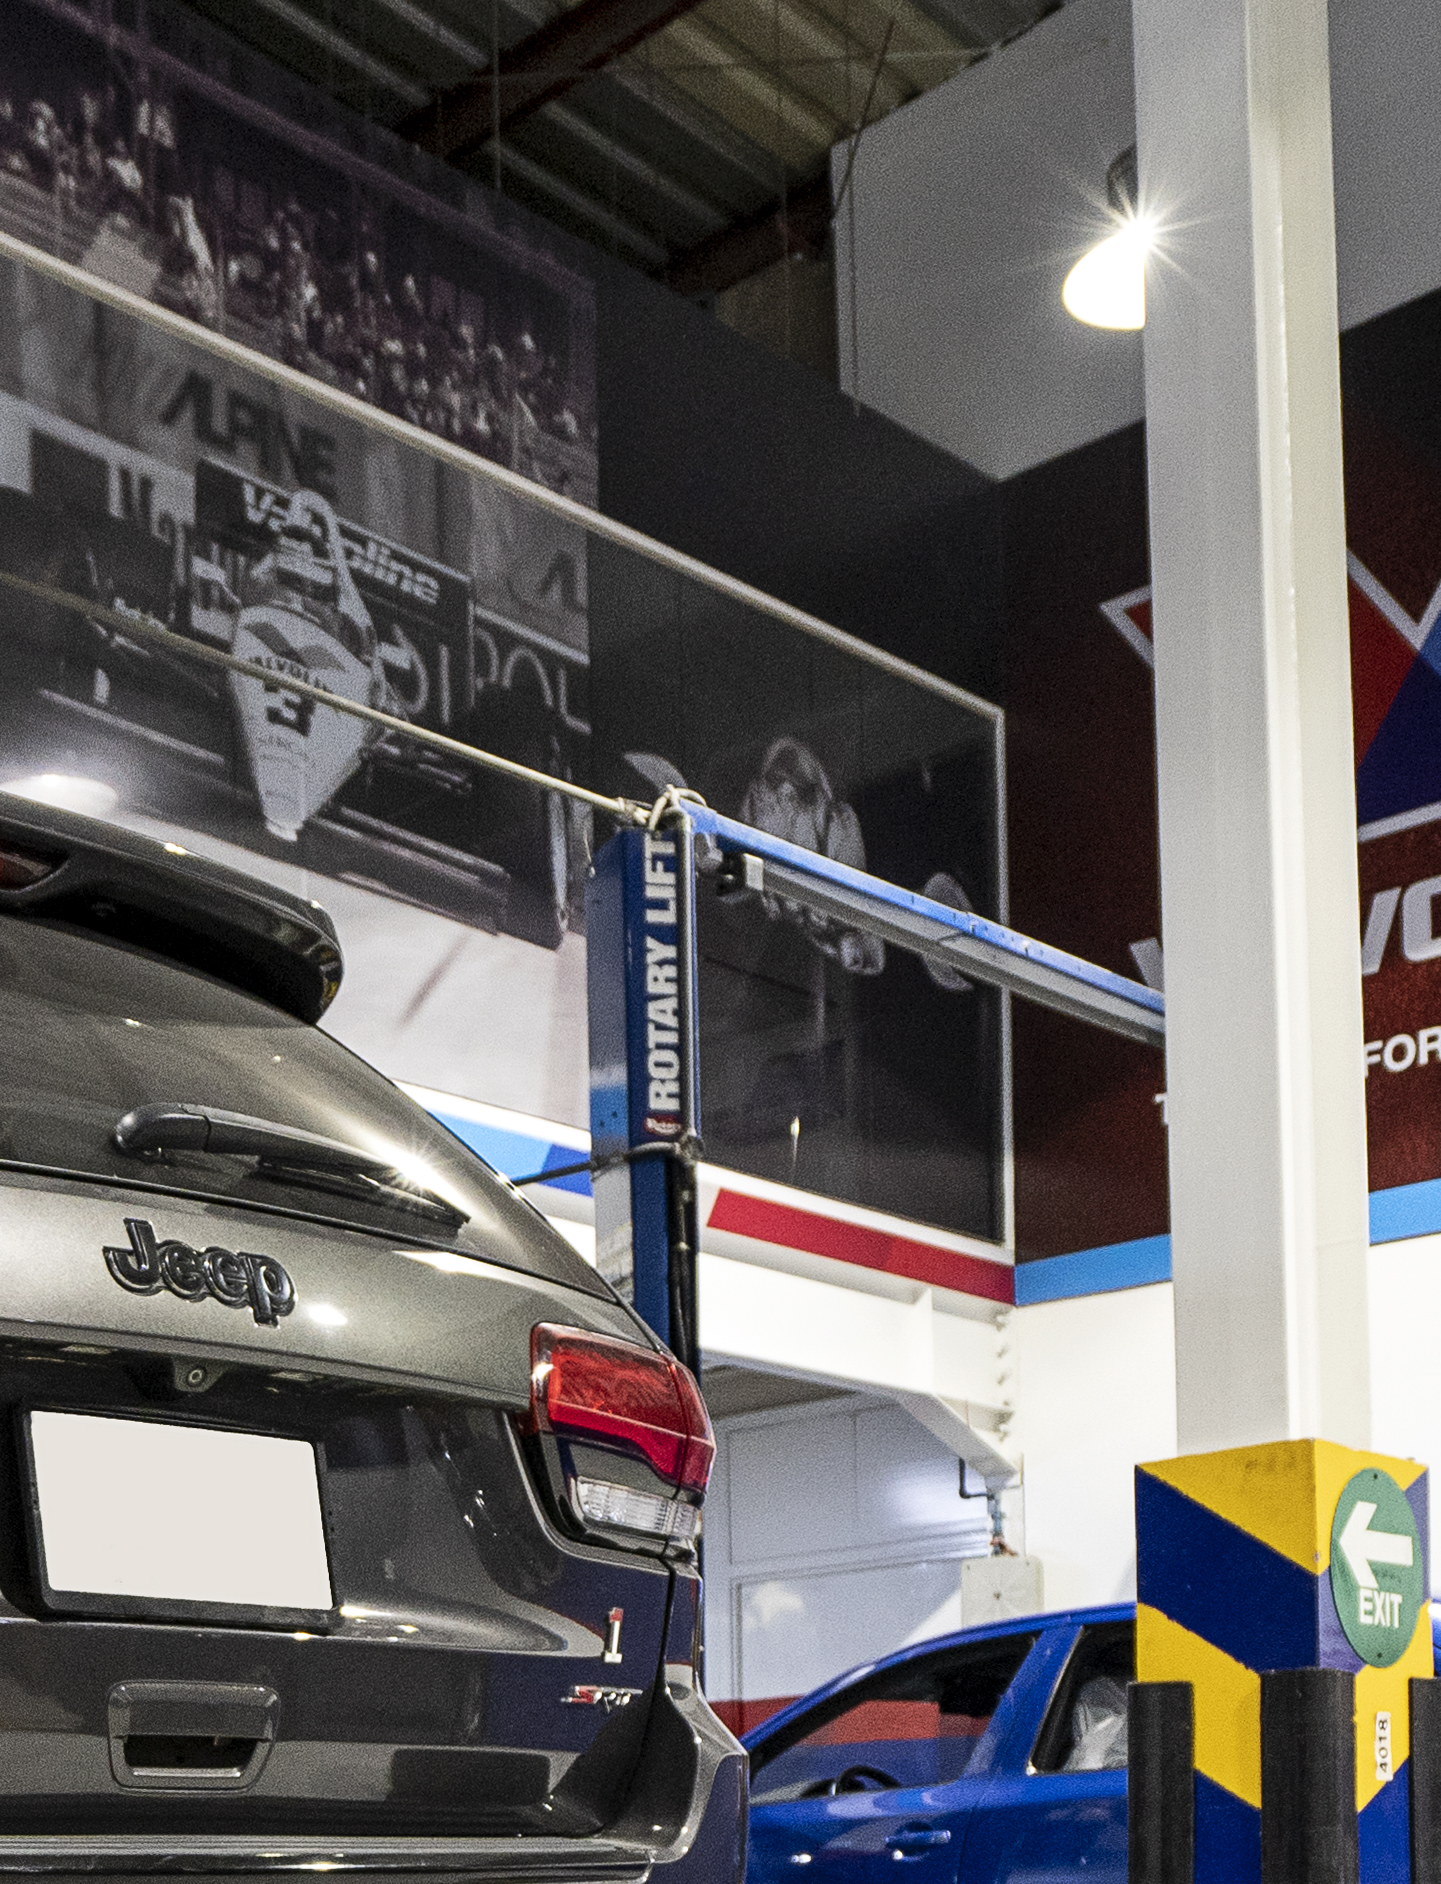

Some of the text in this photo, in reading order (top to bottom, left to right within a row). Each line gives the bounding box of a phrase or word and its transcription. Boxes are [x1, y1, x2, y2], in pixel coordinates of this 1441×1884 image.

[643, 833, 682, 1112] ROTARY LIFT
[102, 1217, 299, 1327] Jeep
[1358, 1587, 1403, 1629] EXIT
[1377, 1718, 1390, 1774] 4018
